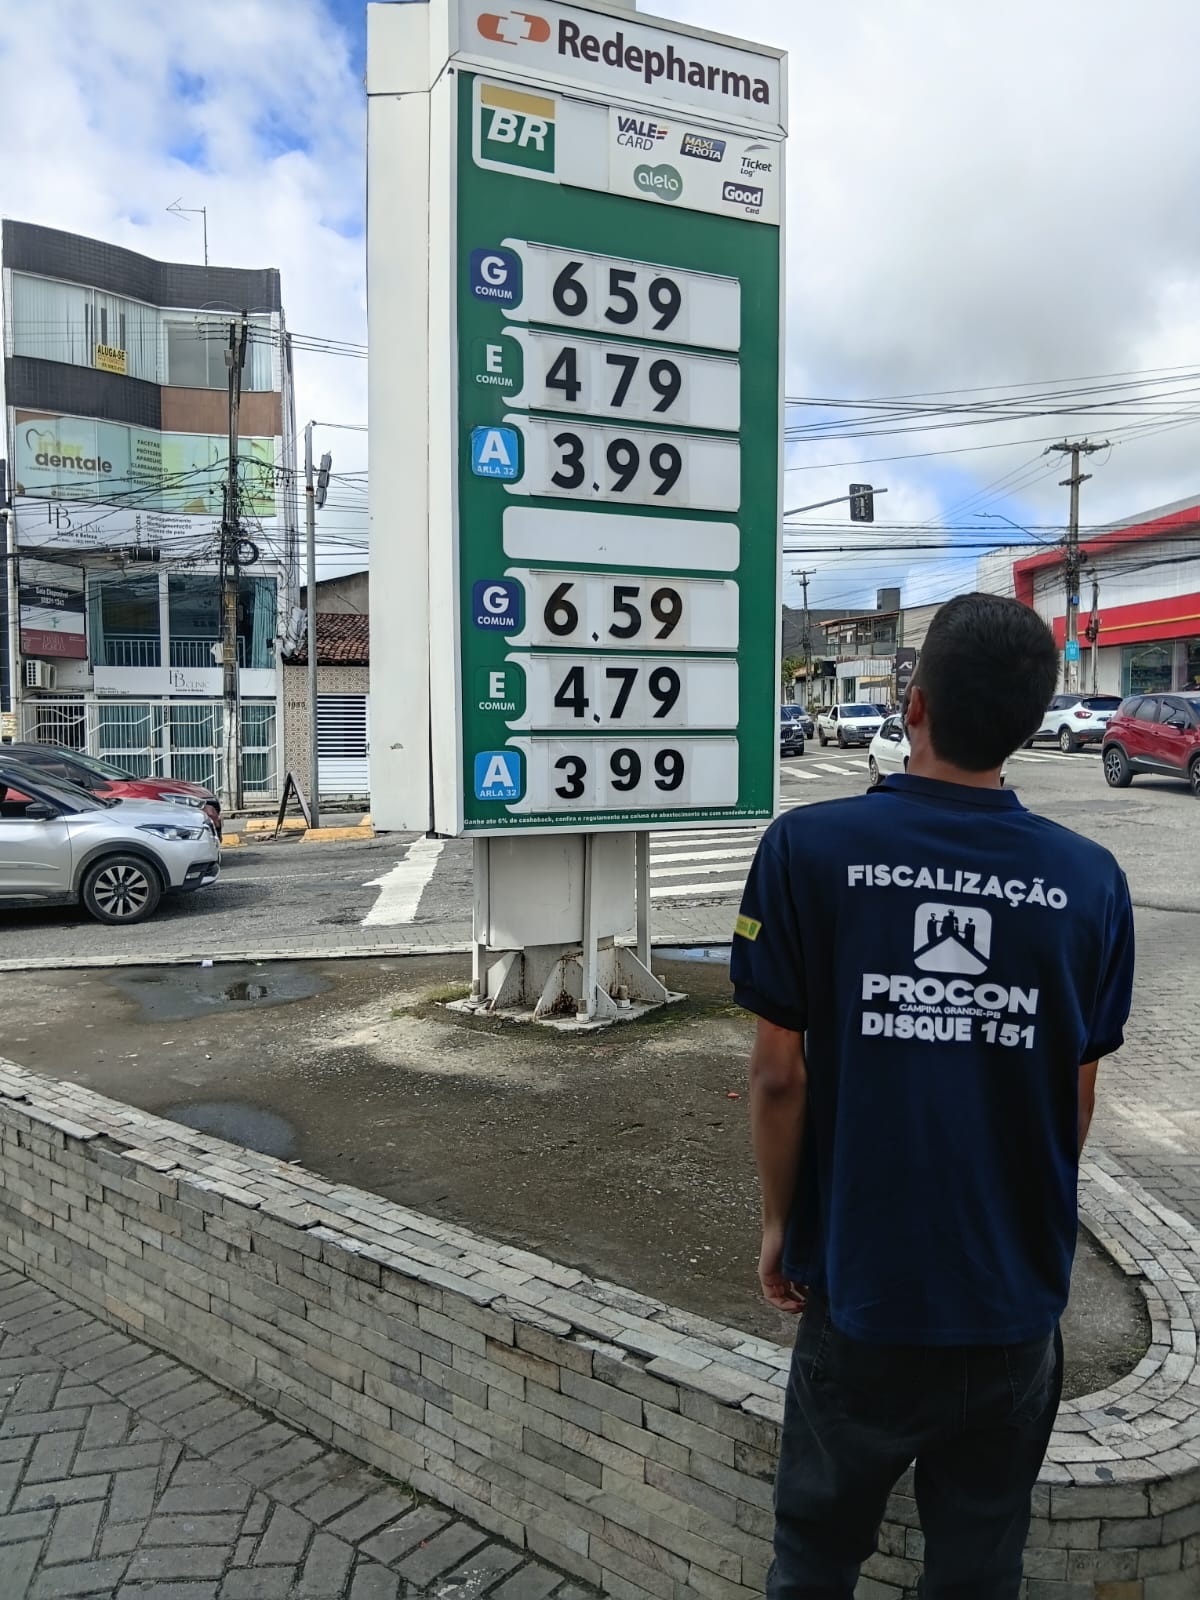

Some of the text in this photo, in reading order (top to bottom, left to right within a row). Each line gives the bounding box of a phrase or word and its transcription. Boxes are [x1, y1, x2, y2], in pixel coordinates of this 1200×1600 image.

[558, 19, 770, 105] Redepharma
[487, 110, 549, 151] BR
[618, 116, 657, 140] VALE
[617, 133, 653, 151] CARD
[685, 136, 713, 150] MAXI
[685, 146, 721, 160] FROTA
[741, 157, 772, 172] Ticket
[638, 171, 679, 191] alelo
[724, 185, 762, 205] Good
[745, 206, 760, 215] Card
[480, 256, 508, 285] G
[475, 286, 513, 300] COMUM
[486, 343, 503, 373] E
[476, 374, 513, 388] COMUM
[478, 431, 511, 465] A
[35, 453, 112, 473] dentale
[477, 465, 514, 476] ARLA 32
[483, 586, 509, 614] G
[477, 616, 514, 626] COMUM
[489, 671, 505, 699] E
[479, 702, 515, 711] COMUM
[482, 755, 514, 788] A
[506, 789, 517, 797] 32
[847, 864, 1068, 910] FISCALIZAÇÃO
[862, 973, 1039, 1014] PROCON
[899, 1004, 1001, 1019] CAMPINA GRANDE-PB
[861, 1012, 1036, 1049] DISQUE 151
